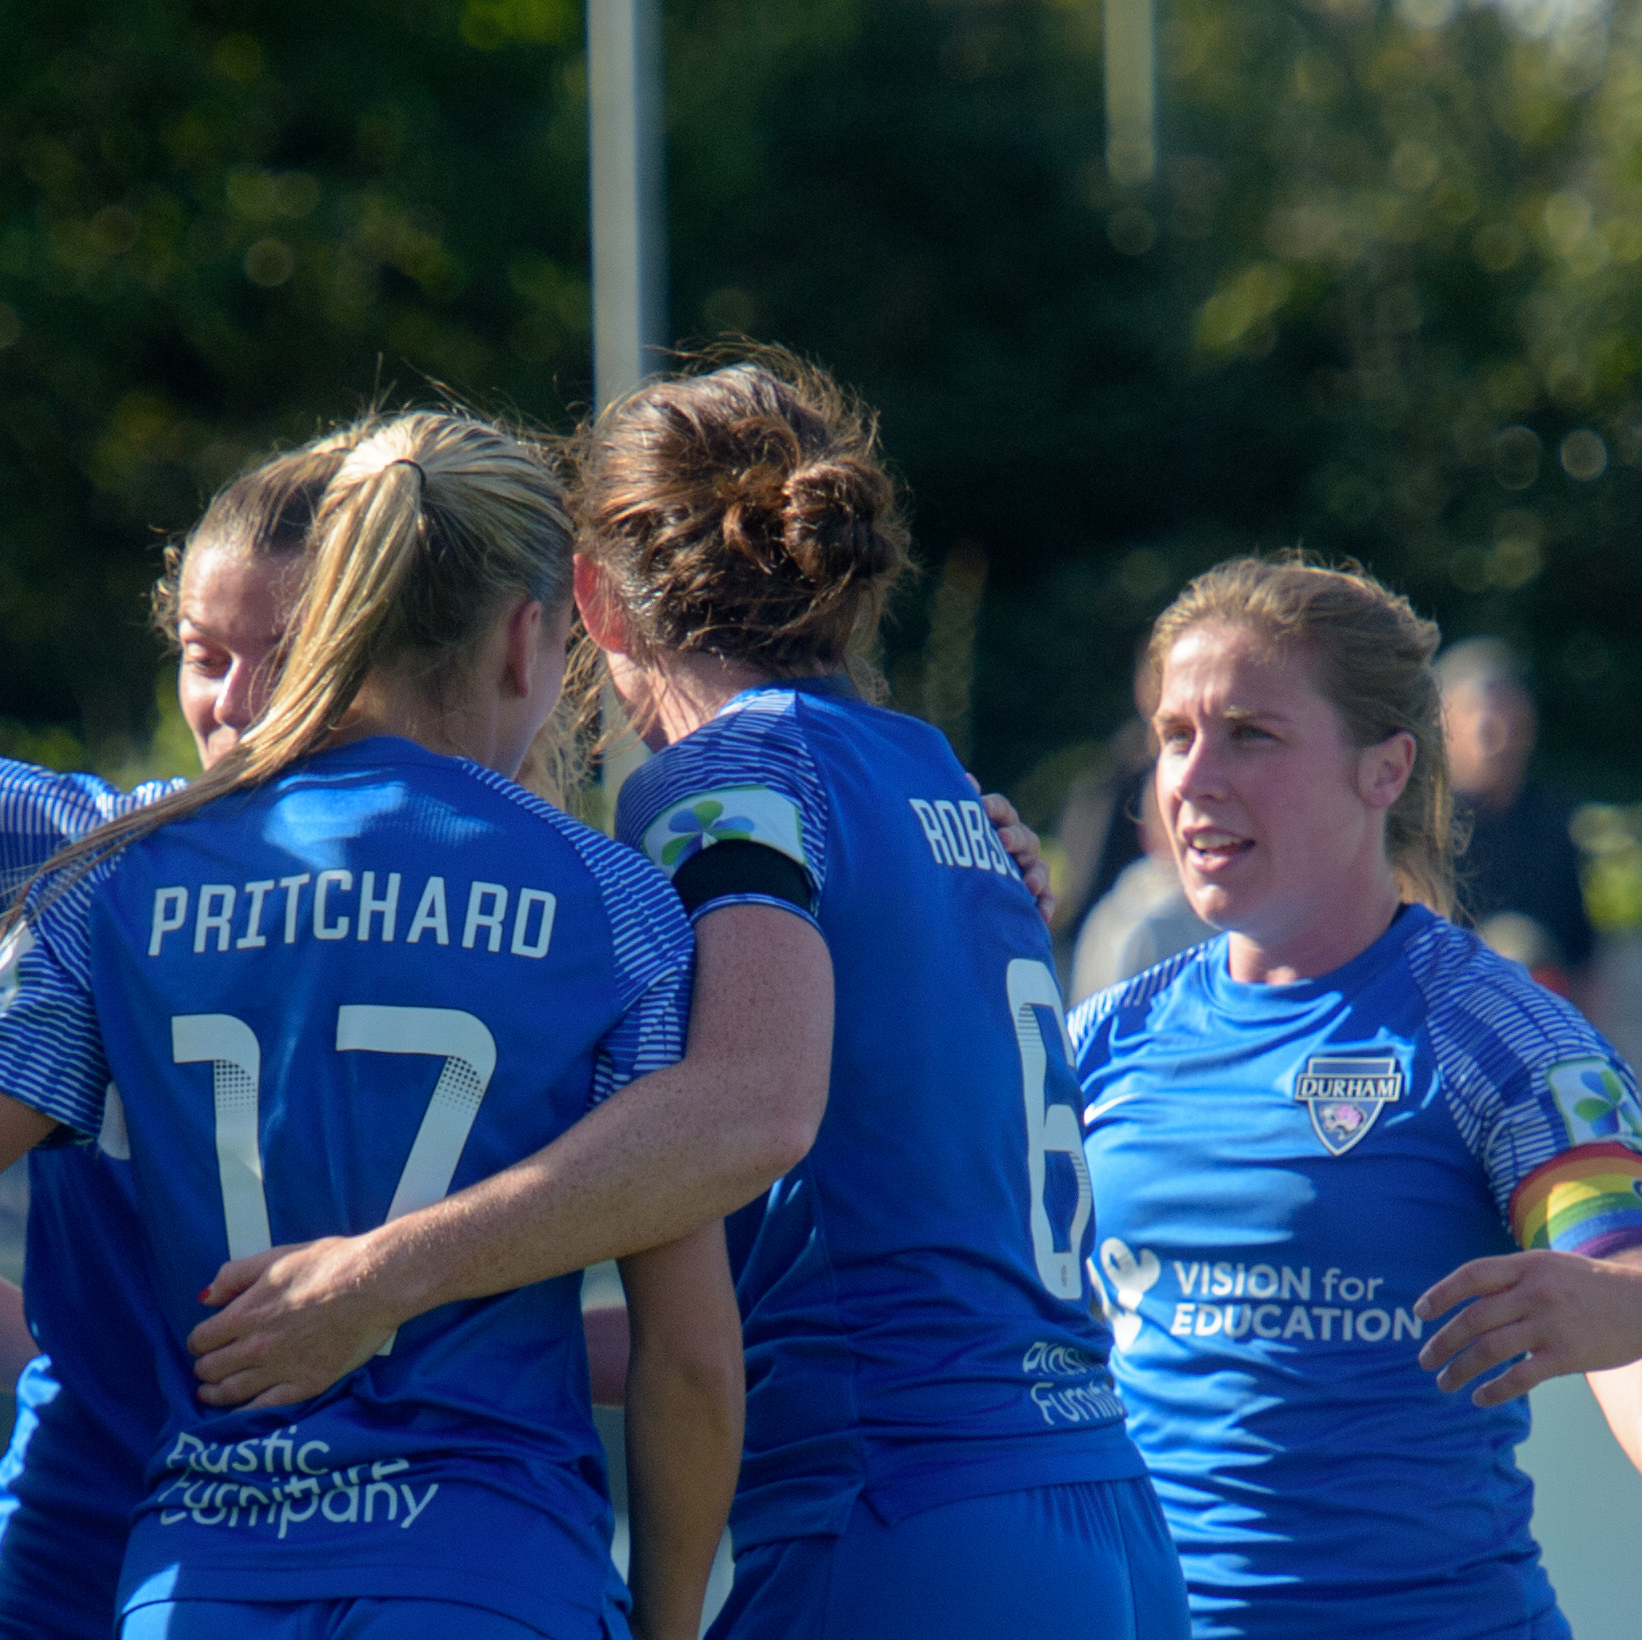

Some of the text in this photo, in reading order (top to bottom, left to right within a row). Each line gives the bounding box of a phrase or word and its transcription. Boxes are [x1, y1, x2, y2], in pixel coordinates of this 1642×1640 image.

[909, 799, 1022, 882] ROBS
[148, 869, 557, 959] PRITCHARD
[1007, 958, 1093, 1300] 6
[1301, 1078, 1395, 1098] DURHAM
[171, 1004, 497, 1357] 17
[1170, 1302, 1424, 1342] EDUCATION
[1173, 1261, 1384, 1301] VISION for
